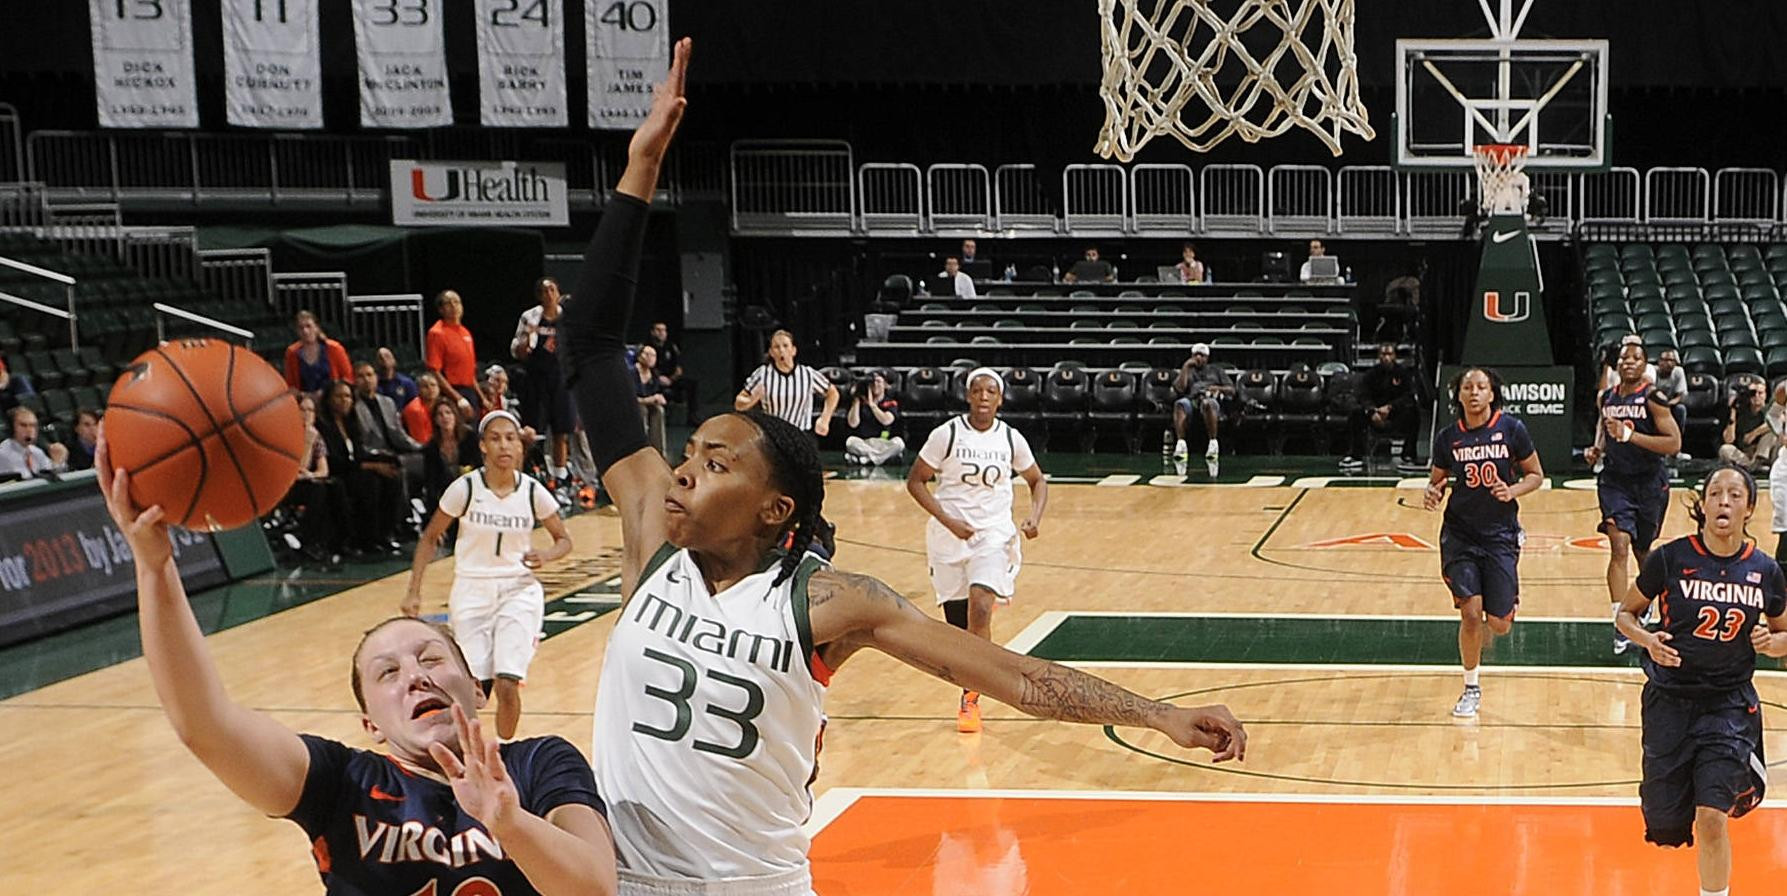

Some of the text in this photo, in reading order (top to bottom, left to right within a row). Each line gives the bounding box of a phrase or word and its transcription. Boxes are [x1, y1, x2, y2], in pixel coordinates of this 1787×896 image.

[372, 0, 429, 26] 33
[492, 0, 549, 28] 24
[600, 0, 657, 32] 40
[255, 63, 289, 75] DON
[619, 68, 644, 80] TIM
[606, 83, 654, 94] JAMES
[1484, 291, 1530, 322] U
[1500, 383, 1565, 402] AMSON
[1526, 403, 1564, 415] GMC
[1452, 444, 1510, 462] VIRGINIA
[961, 462, 1001, 489] 20
[1464, 461, 1498, 488] 30
[23, 531, 86, 584] 2013
[77, 530, 113, 576] by
[495, 531, 503, 556] 1
[1679, 579, 1765, 609] VIRGINIA
[1693, 605, 1746, 642] 23
[632, 647, 765, 760] 33
[353, 813, 504, 869] VIRGIN
